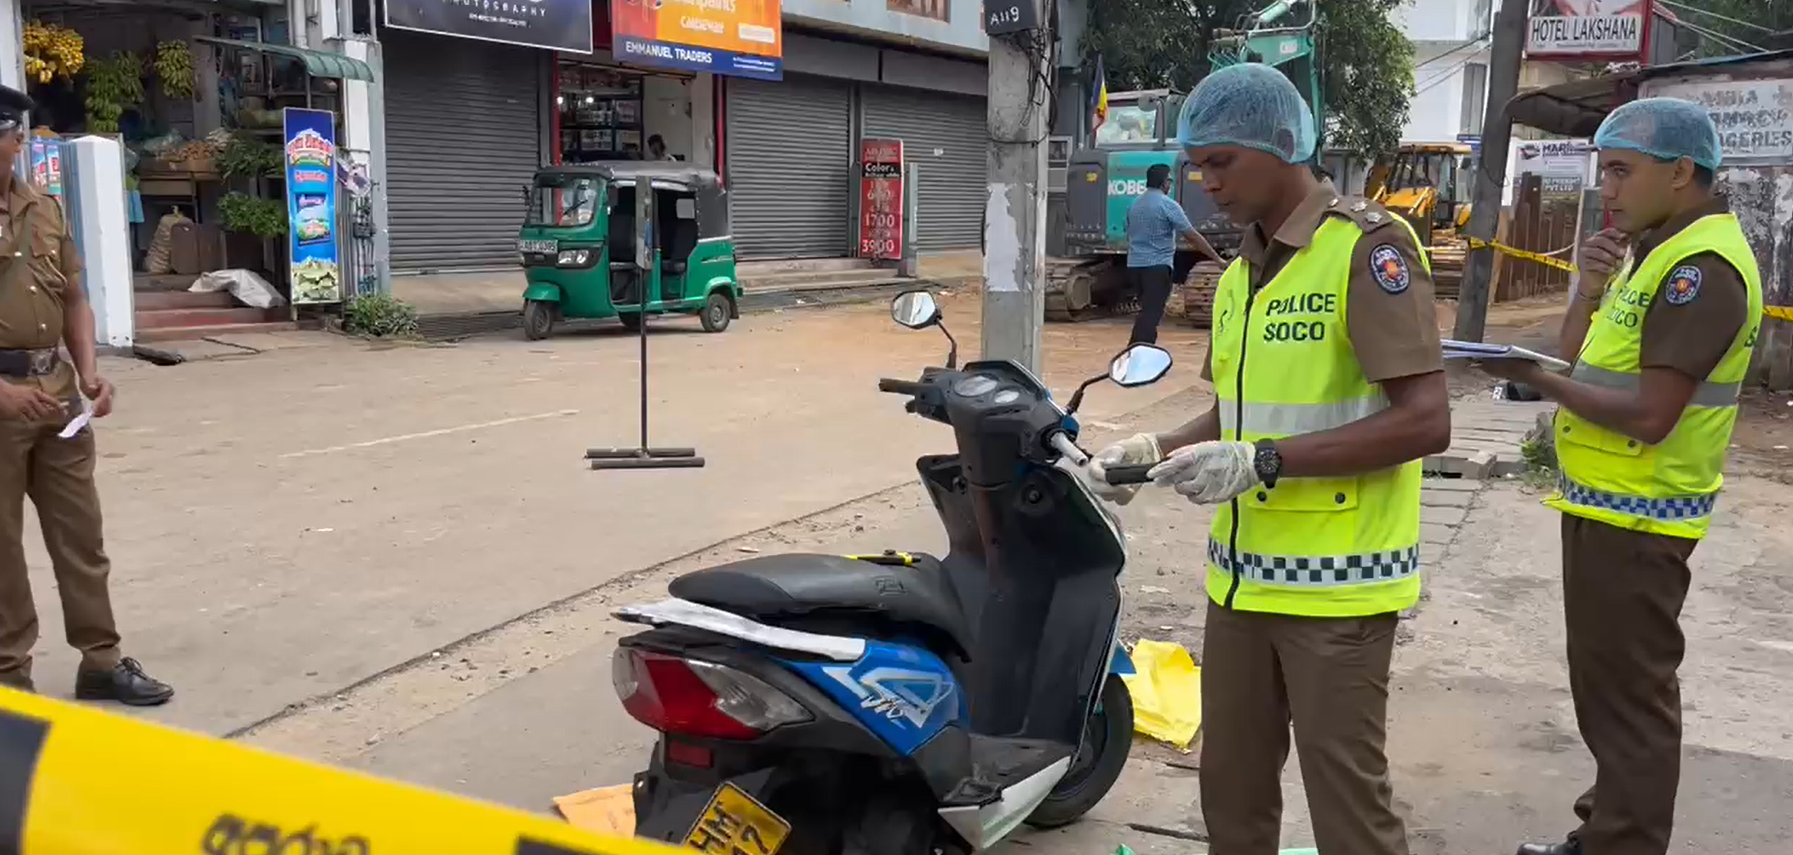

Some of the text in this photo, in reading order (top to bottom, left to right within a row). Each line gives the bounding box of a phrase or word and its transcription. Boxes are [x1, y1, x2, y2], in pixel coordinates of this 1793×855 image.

[990, 5, 1020, 26] A119
[1532, 16, 1637, 41] HOTEL LAKSHANA
[625, 41, 713, 64] EMMANUEL TRADERS
[865, 162, 889, 172] Color
[1107, 179, 1148, 196] KOBE
[1265, 292, 1337, 317] POLICE
[1263, 321, 1325, 342] SOCO
